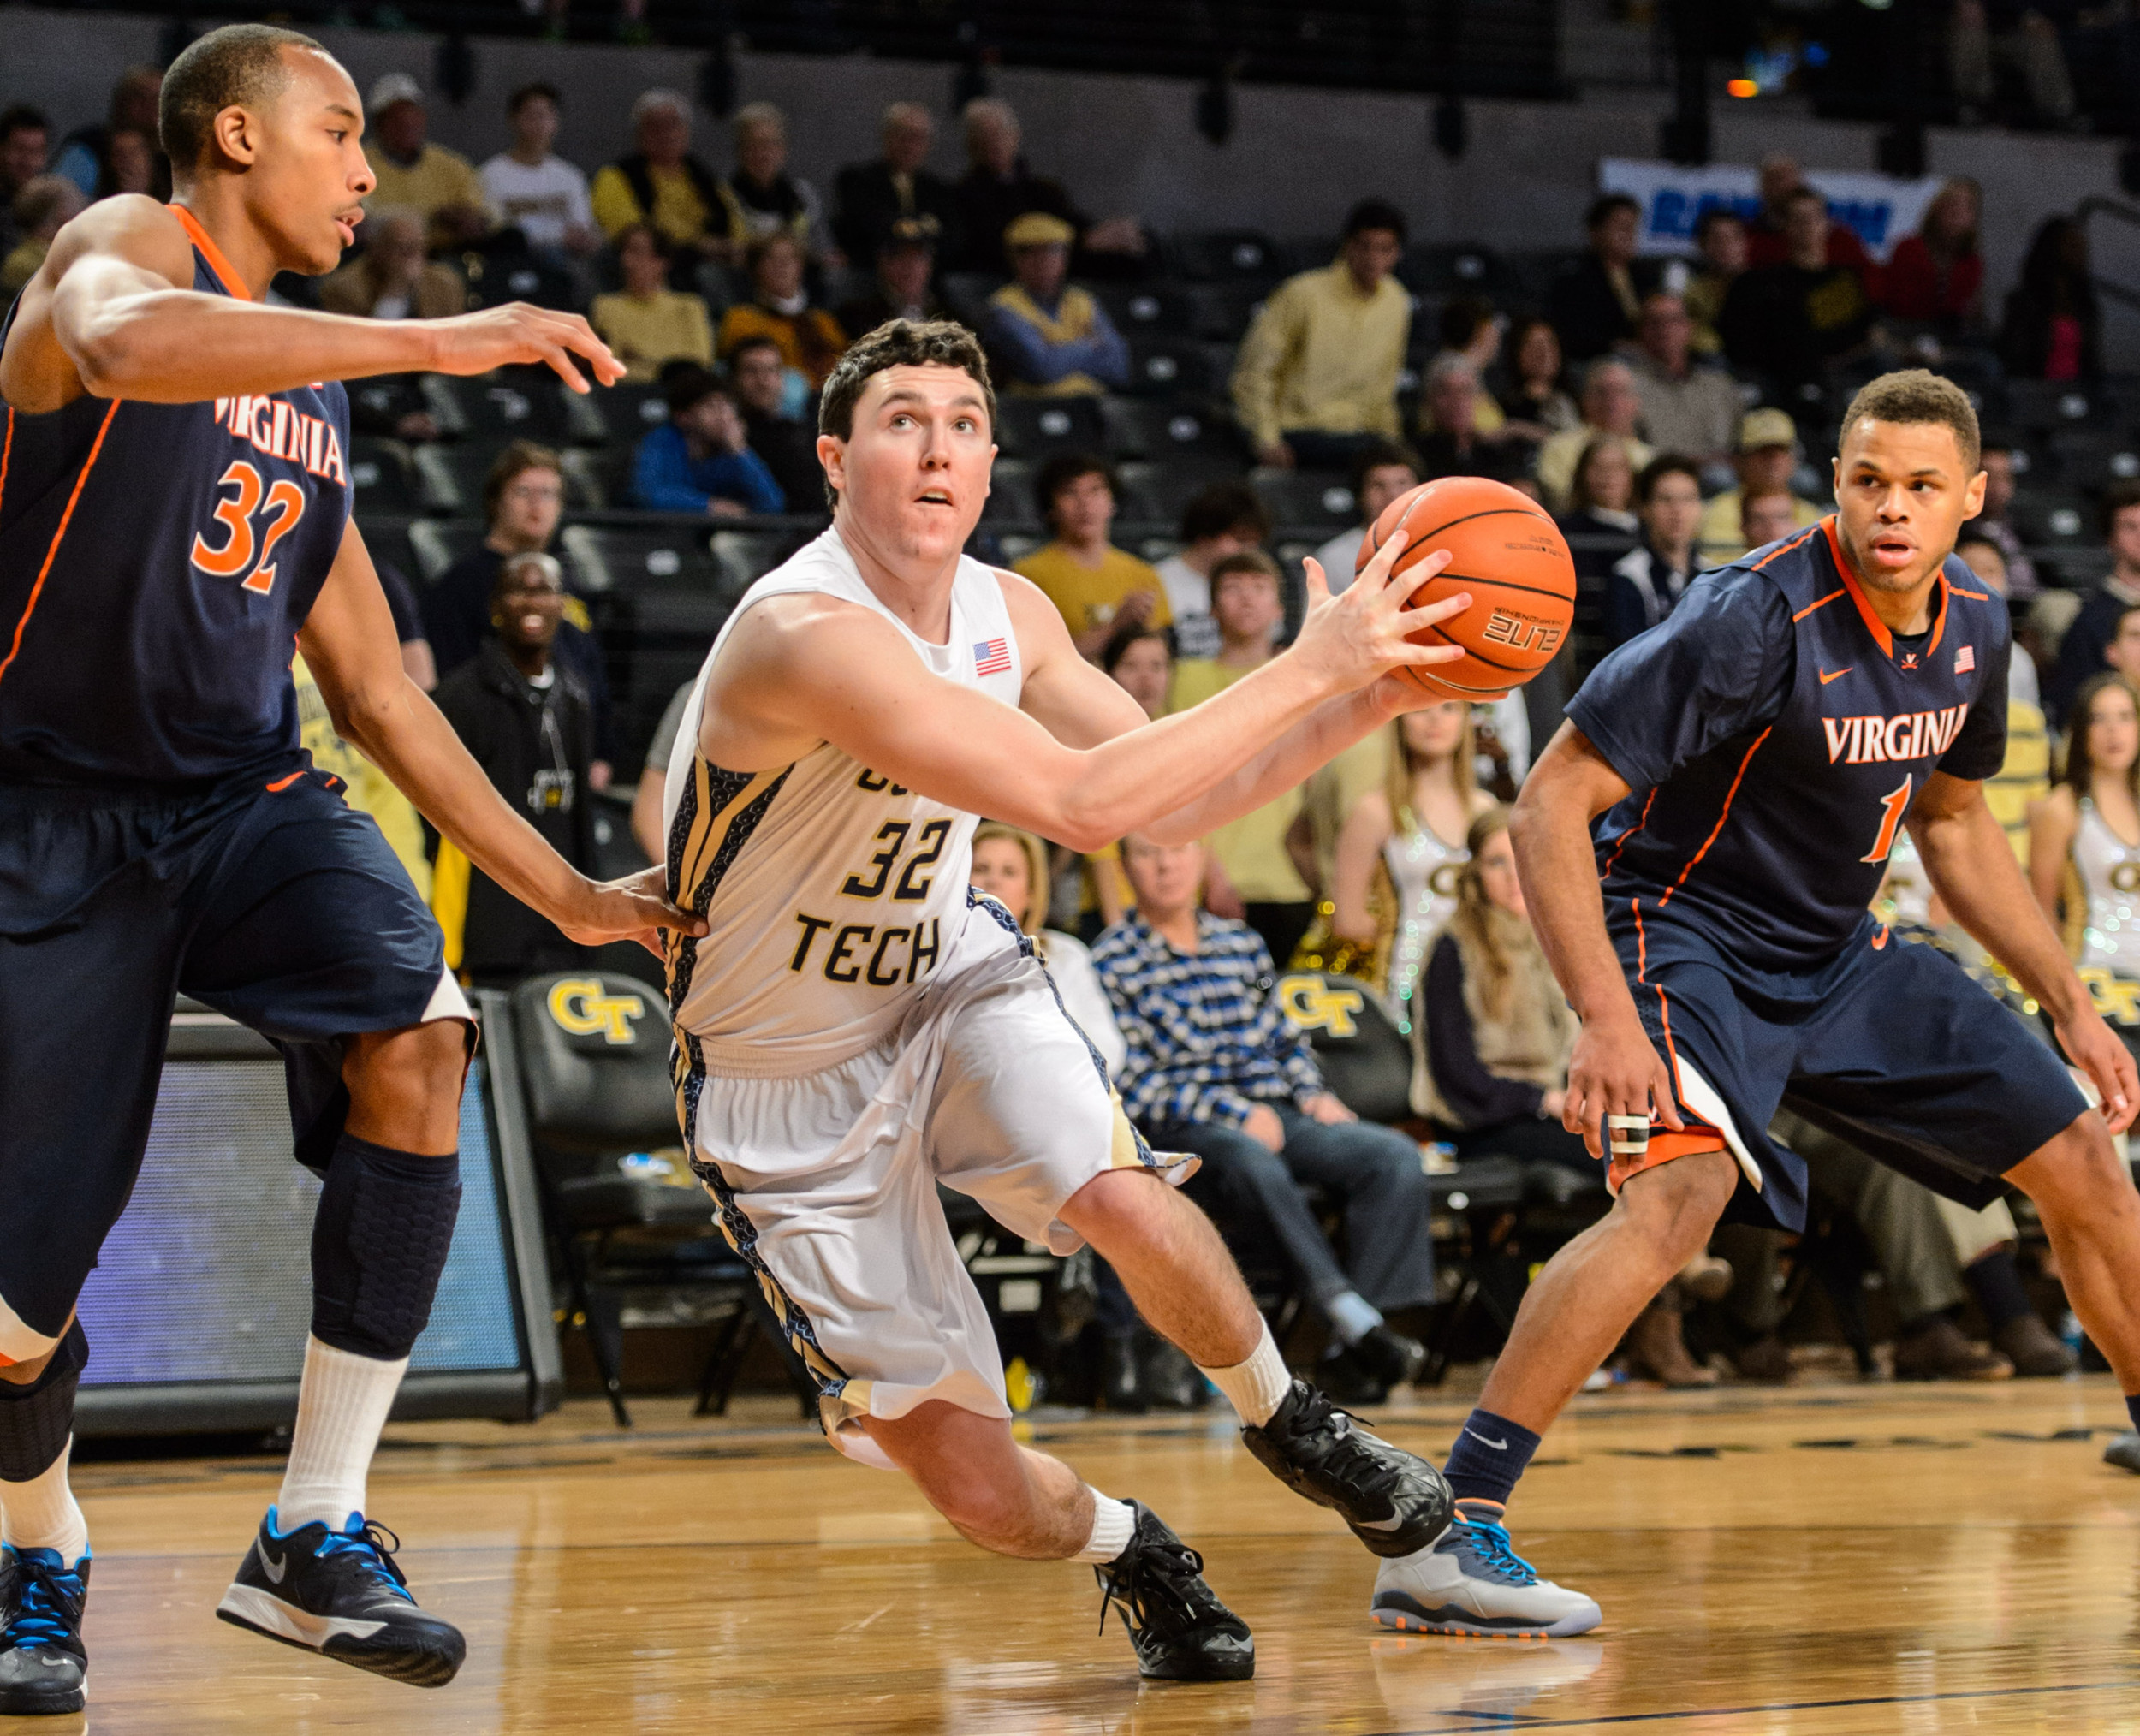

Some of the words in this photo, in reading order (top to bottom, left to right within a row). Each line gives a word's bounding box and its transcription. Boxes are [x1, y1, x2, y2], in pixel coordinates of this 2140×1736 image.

[190, 460, 306, 595] 32
[1482, 613, 1562, 653] ELITE
[1822, 703, 1969, 765] VIRGINIA
[1859, 772, 1913, 863] 1
[836, 816, 954, 904] 32
[787, 910, 941, 988] TECH
[547, 978, 645, 1045] GT
